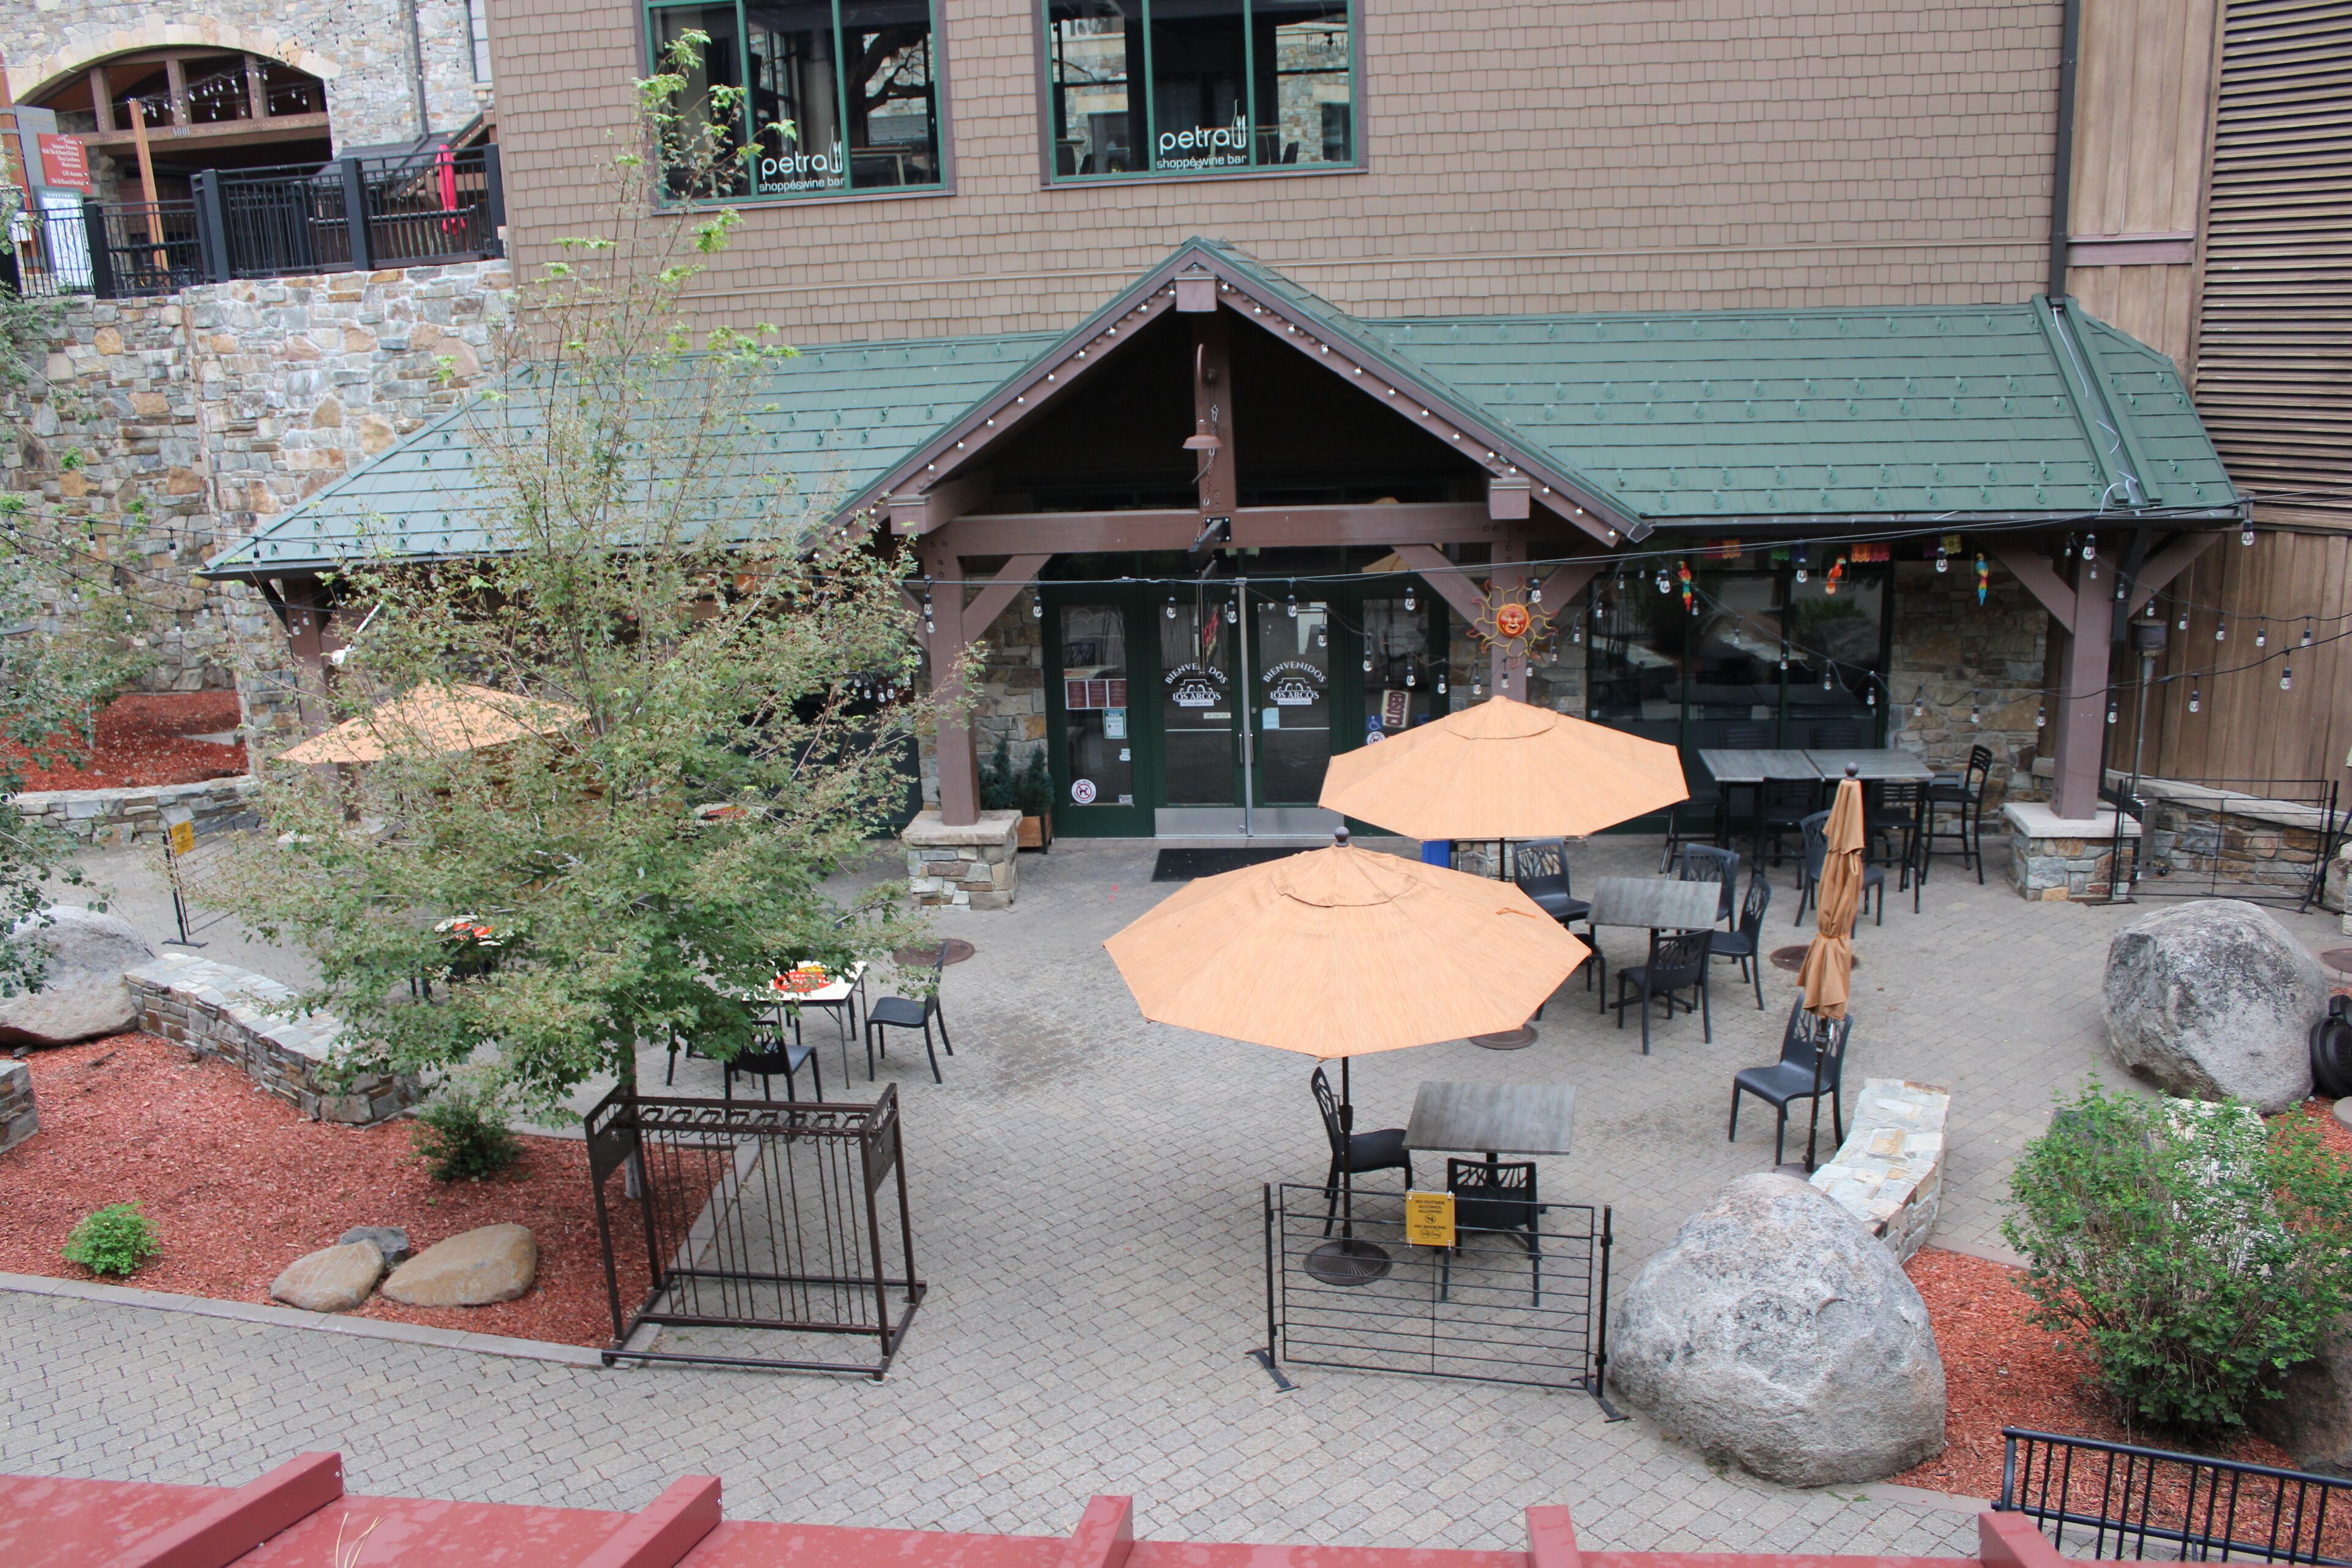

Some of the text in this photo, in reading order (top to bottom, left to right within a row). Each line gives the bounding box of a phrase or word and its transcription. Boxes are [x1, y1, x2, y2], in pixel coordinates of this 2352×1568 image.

[1159, 126, 1230, 155] petra
[761, 151, 827, 180] petra
[1227, 153, 1247, 164] bar
[827, 176, 845, 186] bar
[1165, 663, 1228, 684] BIENVEDOS
[1263, 662, 1327, 682] BIENVENIDOS
[1173, 693, 1188, 702] LOS
[1270, 692, 1286, 700] LOS
[1385, 692, 1406, 726] CLOSED
